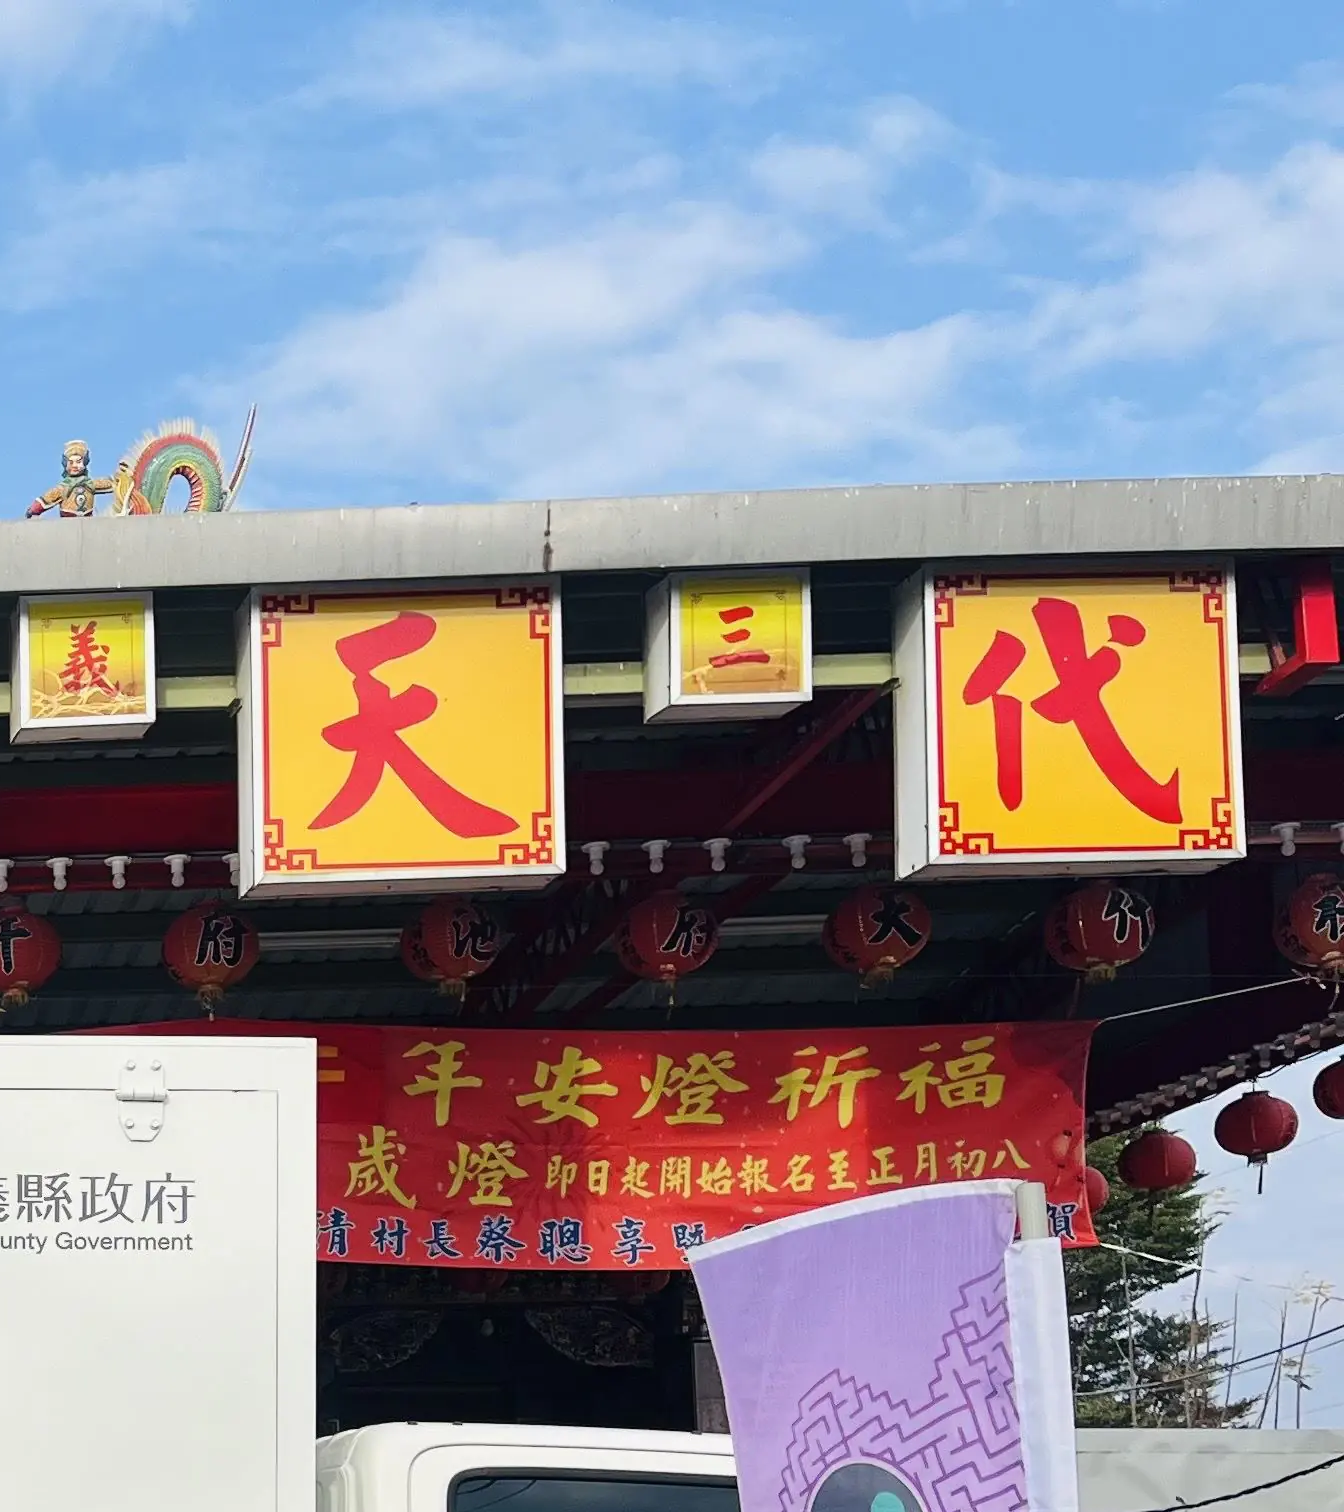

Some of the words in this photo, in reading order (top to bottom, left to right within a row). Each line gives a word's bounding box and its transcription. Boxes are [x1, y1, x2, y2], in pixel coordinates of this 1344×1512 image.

[59, 624, 122, 698] 義
[709, 606, 772, 668] 三
[307, 610, 520, 839] 天
[962, 597, 1184, 824] 代
[195, 912, 246, 967] 府
[450, 906, 499, 961] 池
[343, 1125, 529, 1209] 歲燈
[544, 1138, 1032, 1200] 即日起開始報名至正月初八
[55, 1232, 194, 1252] Government
